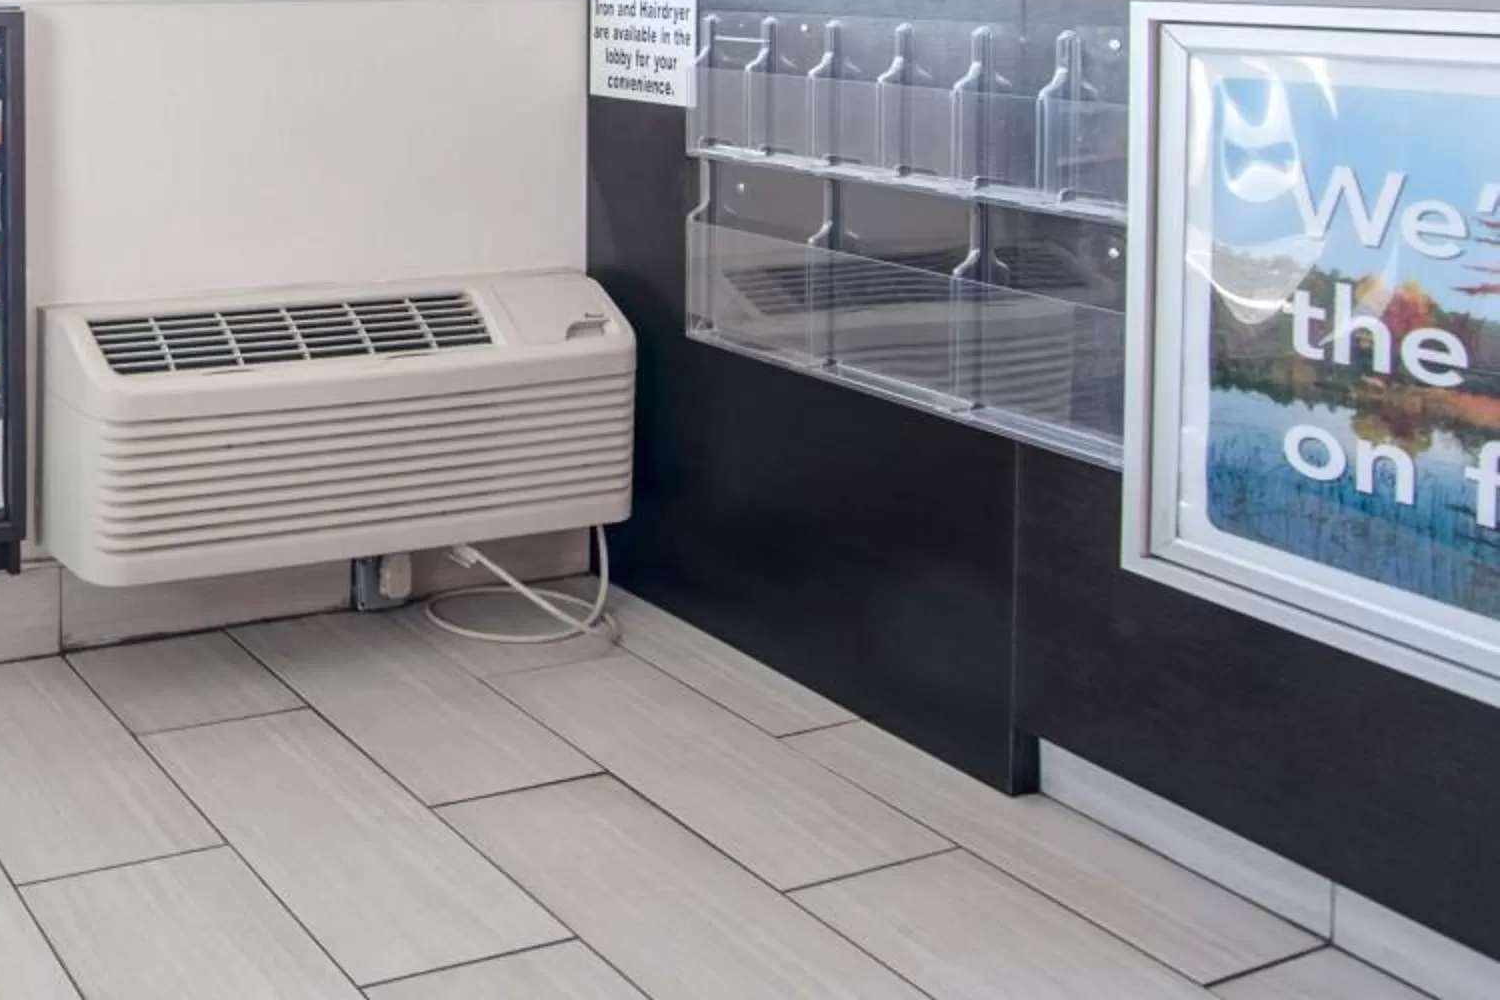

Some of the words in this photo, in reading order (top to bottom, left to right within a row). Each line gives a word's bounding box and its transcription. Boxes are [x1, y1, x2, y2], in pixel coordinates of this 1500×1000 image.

[617, 0, 637, 18] and
[639, 0, 691, 25] Hairdryer
[593, 26, 610, 40] are
[613, 26, 657, 43] available
[661, 28, 671, 45] in
[673, 29, 691, 47] the
[605, 47, 632, 70] lobby
[635, 49, 650, 68] for
[653, 55, 677, 74] your
[607, 75, 675, 96] convenience.
[1284, 281, 1469, 388] the
[1284, 424, 1416, 506] on
